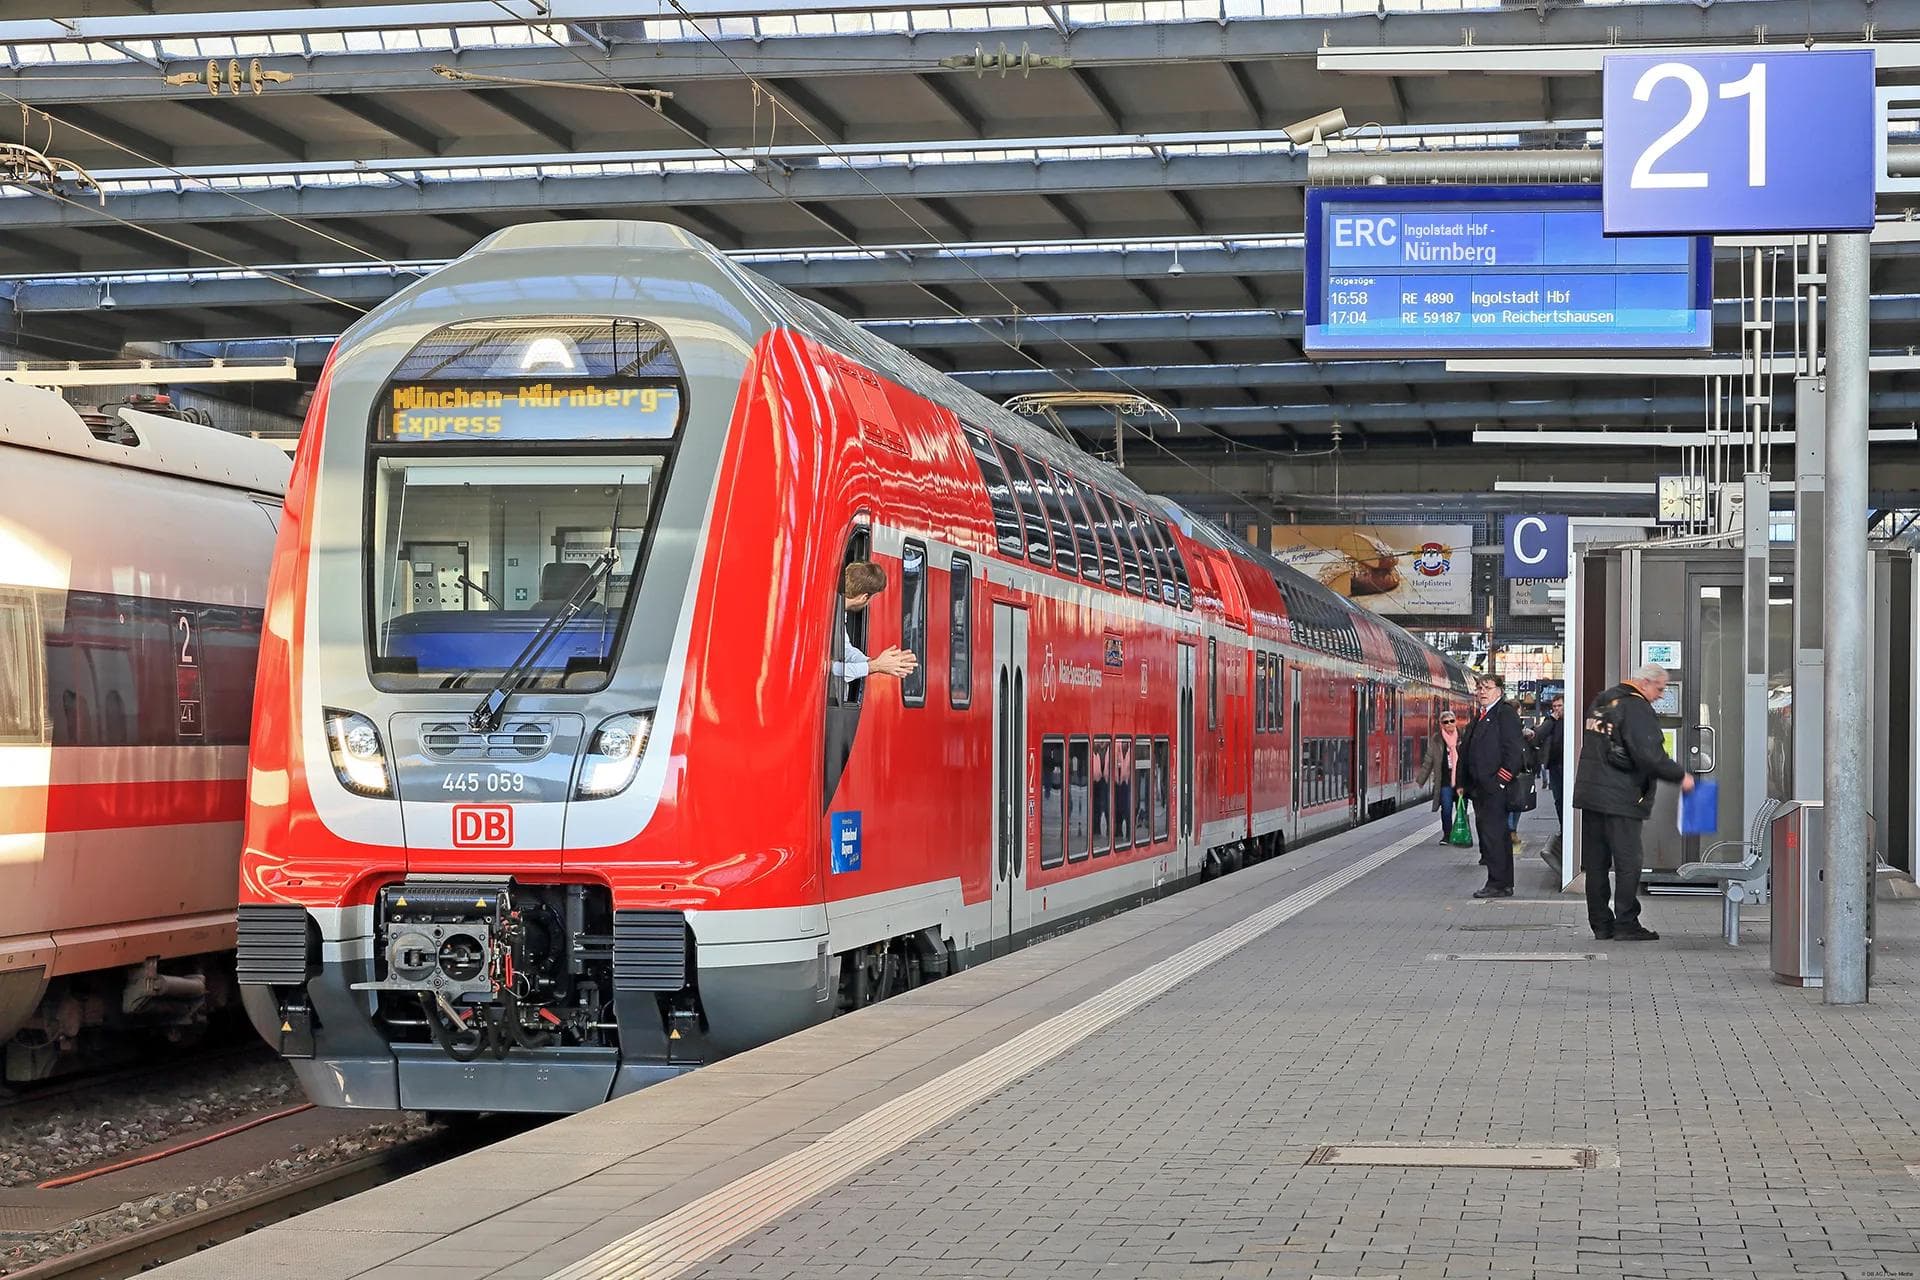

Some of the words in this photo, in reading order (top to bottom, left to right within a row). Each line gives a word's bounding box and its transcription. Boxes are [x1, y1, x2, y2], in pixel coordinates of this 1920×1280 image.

[1630, 62, 1767, 190] 21
[1335, 217, 1397, 247] ERC
[1404, 223, 1464, 239] Ingolstadt
[1467, 223, 1488, 236] Hbf
[1404, 241, 1496, 265] Nürnberg
[1330, 277, 1376, 286] Folgezüge:
[1331, 291, 1368, 305] 16:58
[1402, 293, 1418, 305] RE
[1423, 292, 1454, 305] 4890
[1471, 290, 1539, 307] Ingolstadt
[1547, 290, 1571, 304] Hbf
[1330, 311, 1368, 325] 17:04
[1402, 312, 1418, 325] RE
[1423, 311, 1461, 325] 59187
[1471, 313, 1496, 324] von
[1502, 310, 1615, 324] Reichertshausen
[393, 383, 673, 413] München-Nürnberg-
[393, 412, 501, 439] Express
[1513, 516, 1548, 564] C
[1412, 579, 1452, 588] Hofpfisterei
[179, 616, 193, 663] 2
[1519, 680, 1531, 690] 21
[442, 772, 479, 792] 445
[487, 772, 524, 792] 059
[1029, 751, 1035, 794] 2
[460, 811, 506, 841] DB
